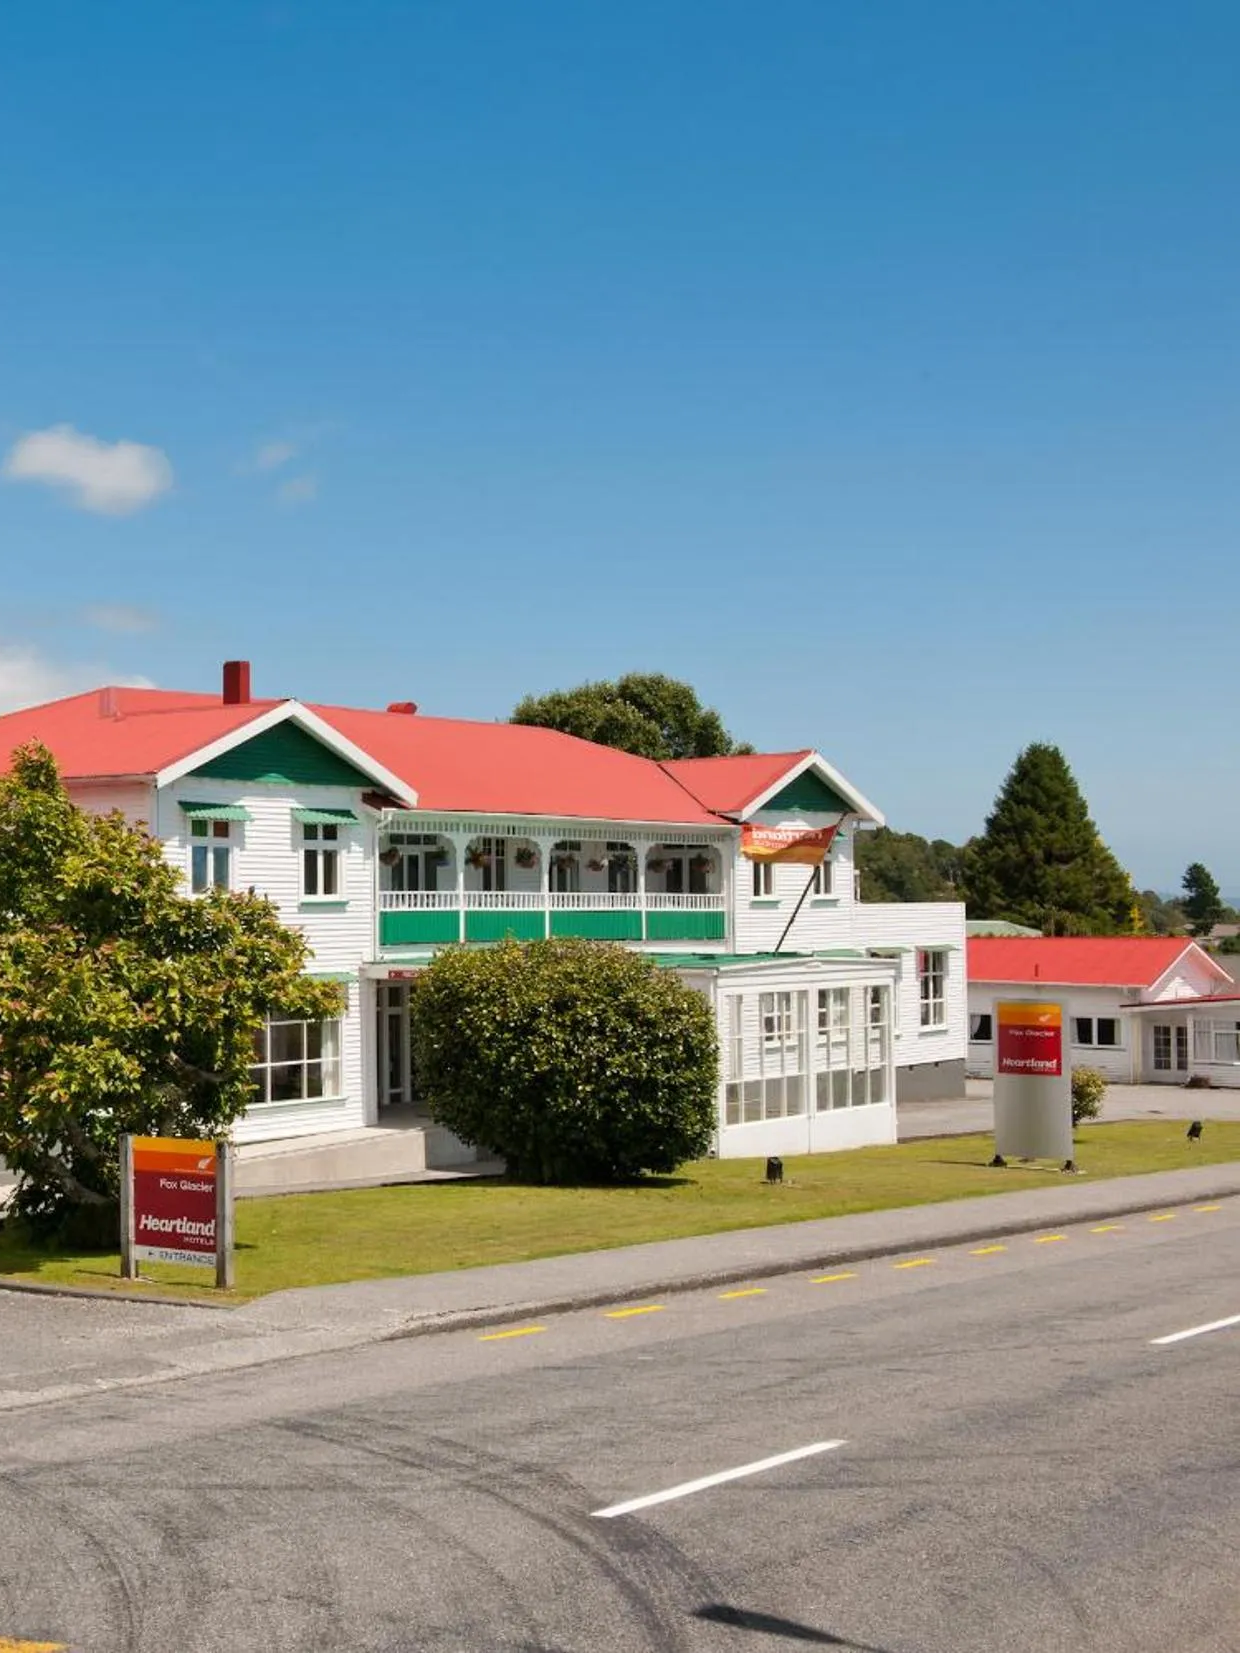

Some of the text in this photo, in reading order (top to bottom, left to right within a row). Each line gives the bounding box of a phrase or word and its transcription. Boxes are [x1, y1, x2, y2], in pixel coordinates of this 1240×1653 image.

[1002, 1057, 1057, 1069] Heartland
[159, 1178, 214, 1193] Fox Glacier
[139, 1214, 215, 1236] Heartland
[183, 1236, 215, 1246] HOTELS
[159, 1250, 215, 1266] ENTRANCE
